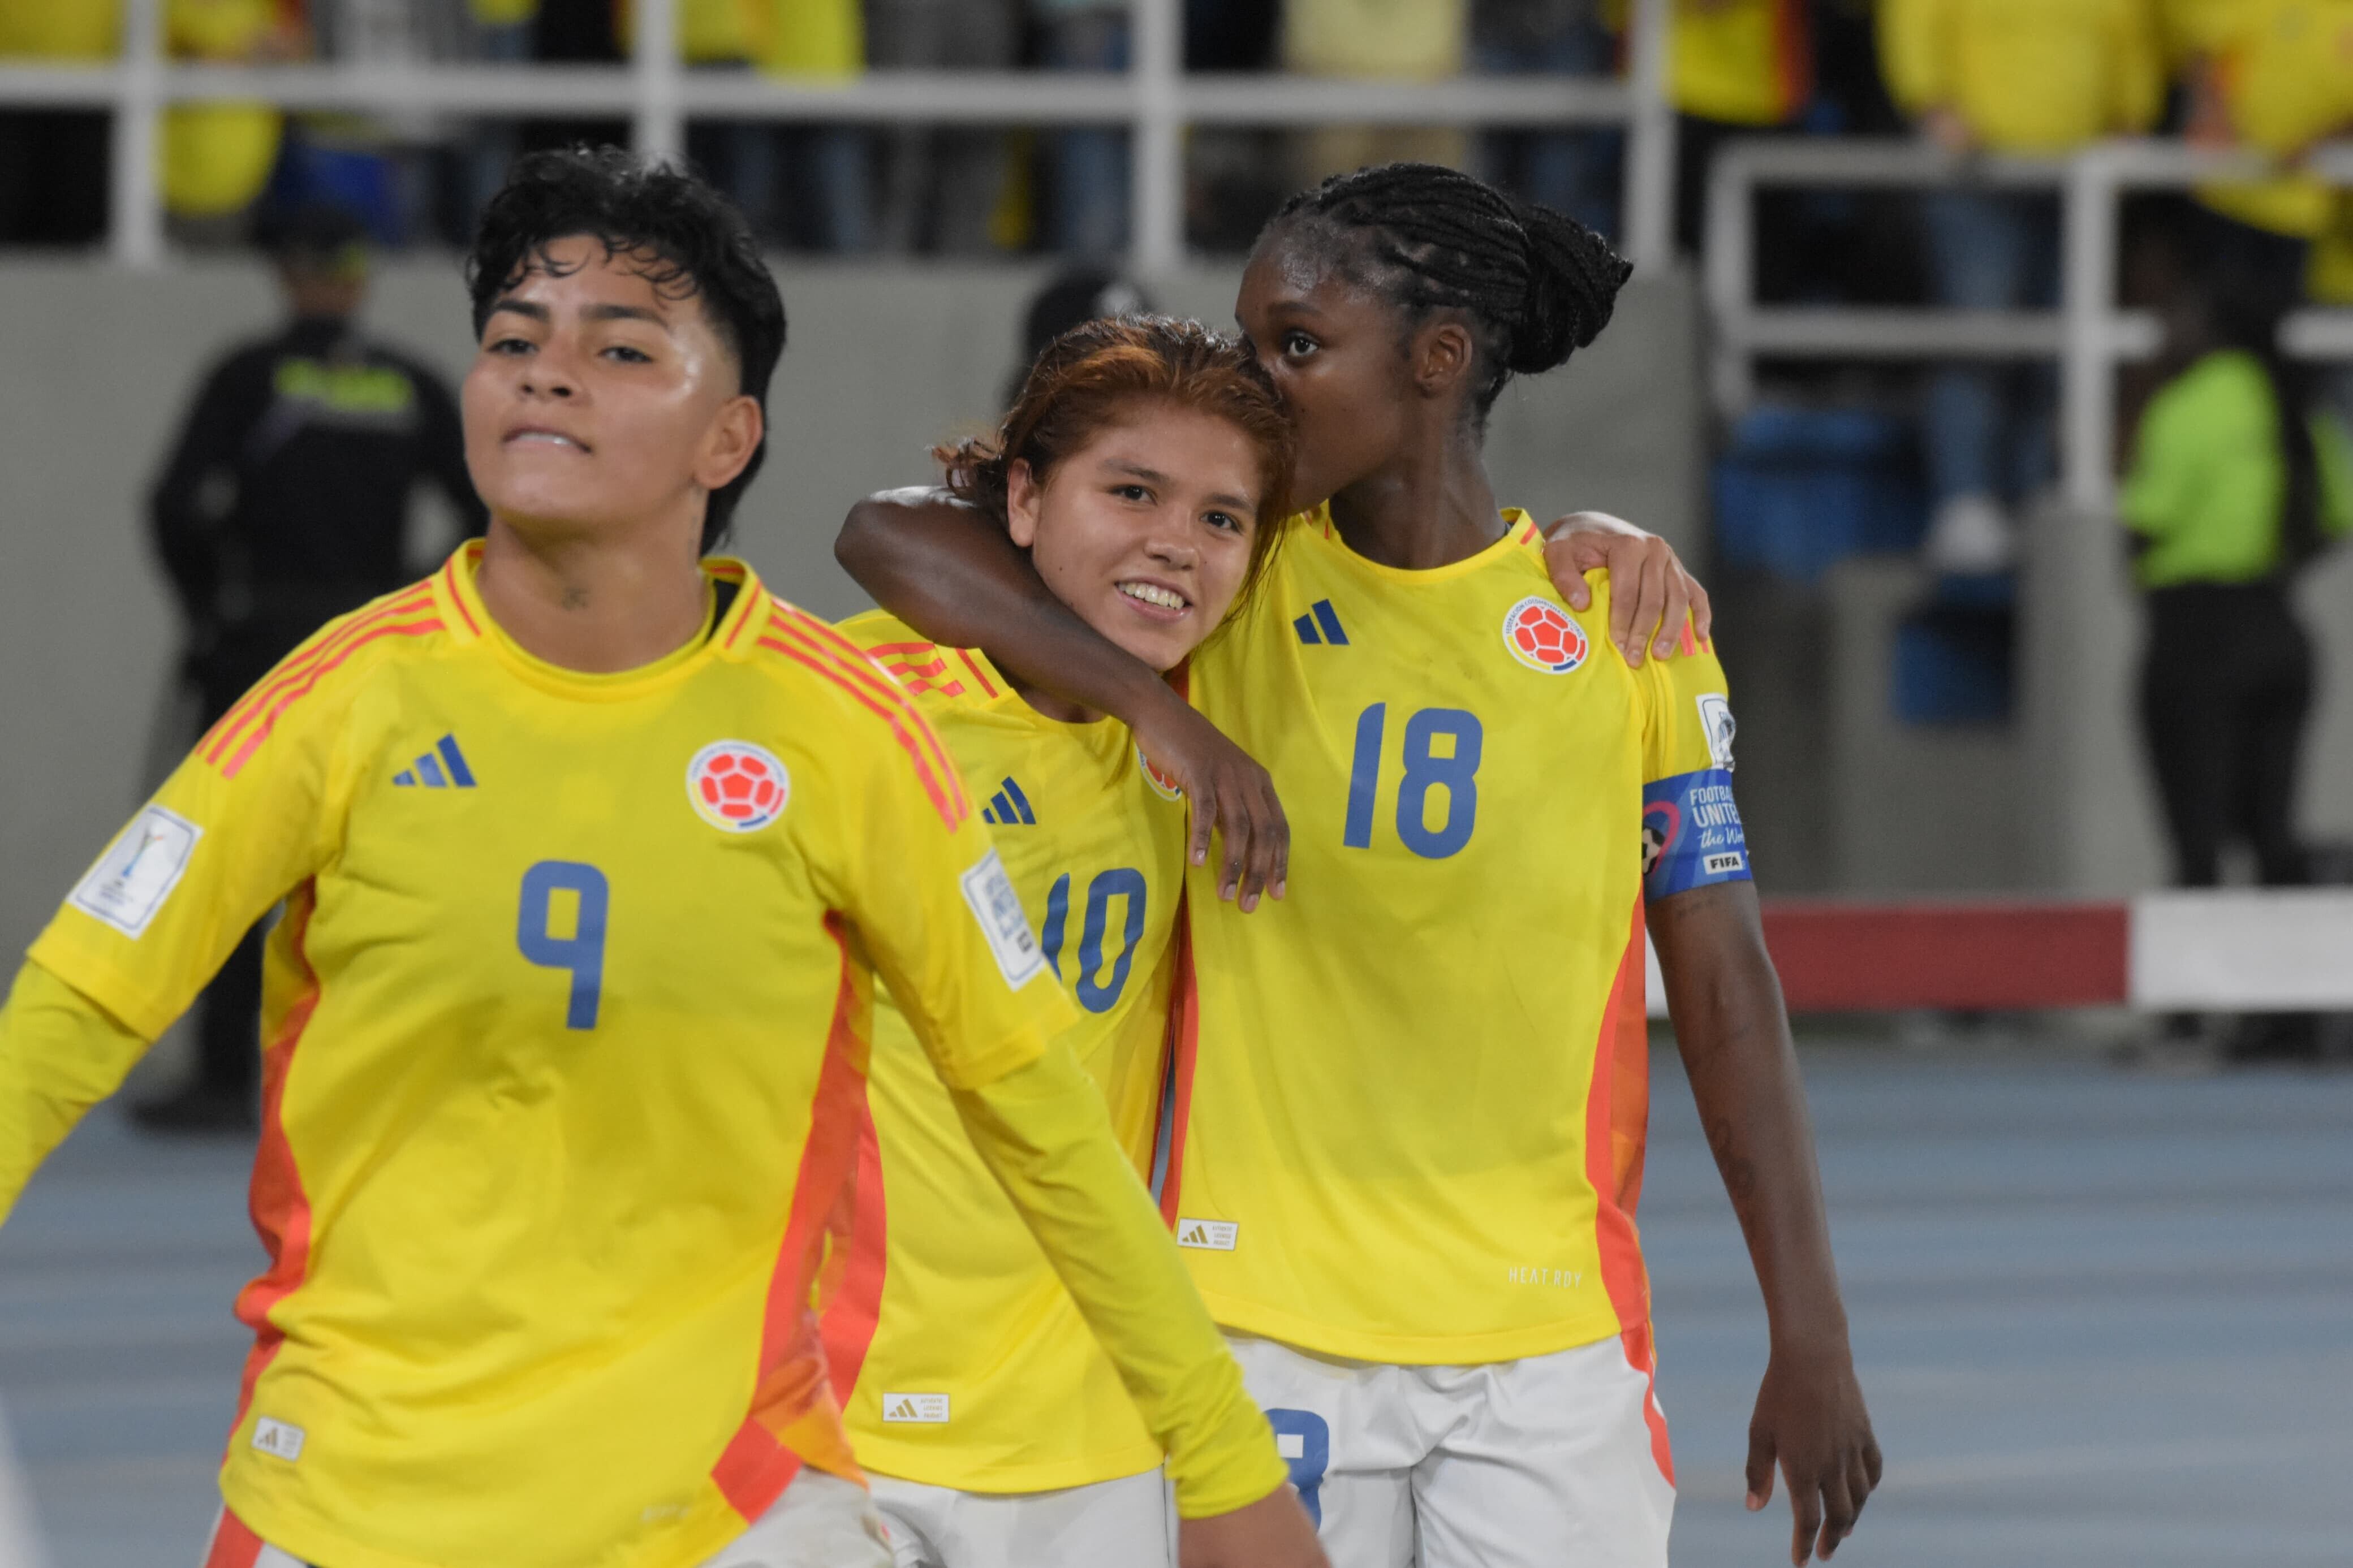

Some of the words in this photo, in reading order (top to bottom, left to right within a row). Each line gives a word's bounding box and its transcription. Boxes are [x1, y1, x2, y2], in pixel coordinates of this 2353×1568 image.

[1343, 702, 1483, 859] 18
[1690, 785, 1733, 806] FOOTBA
[1692, 802, 1742, 828] UNITE
[1697, 828, 1725, 848] the
[1710, 857, 1739, 869] FIFA
[516, 859, 610, 1031] 9
[1041, 866, 1147, 1013] 10
